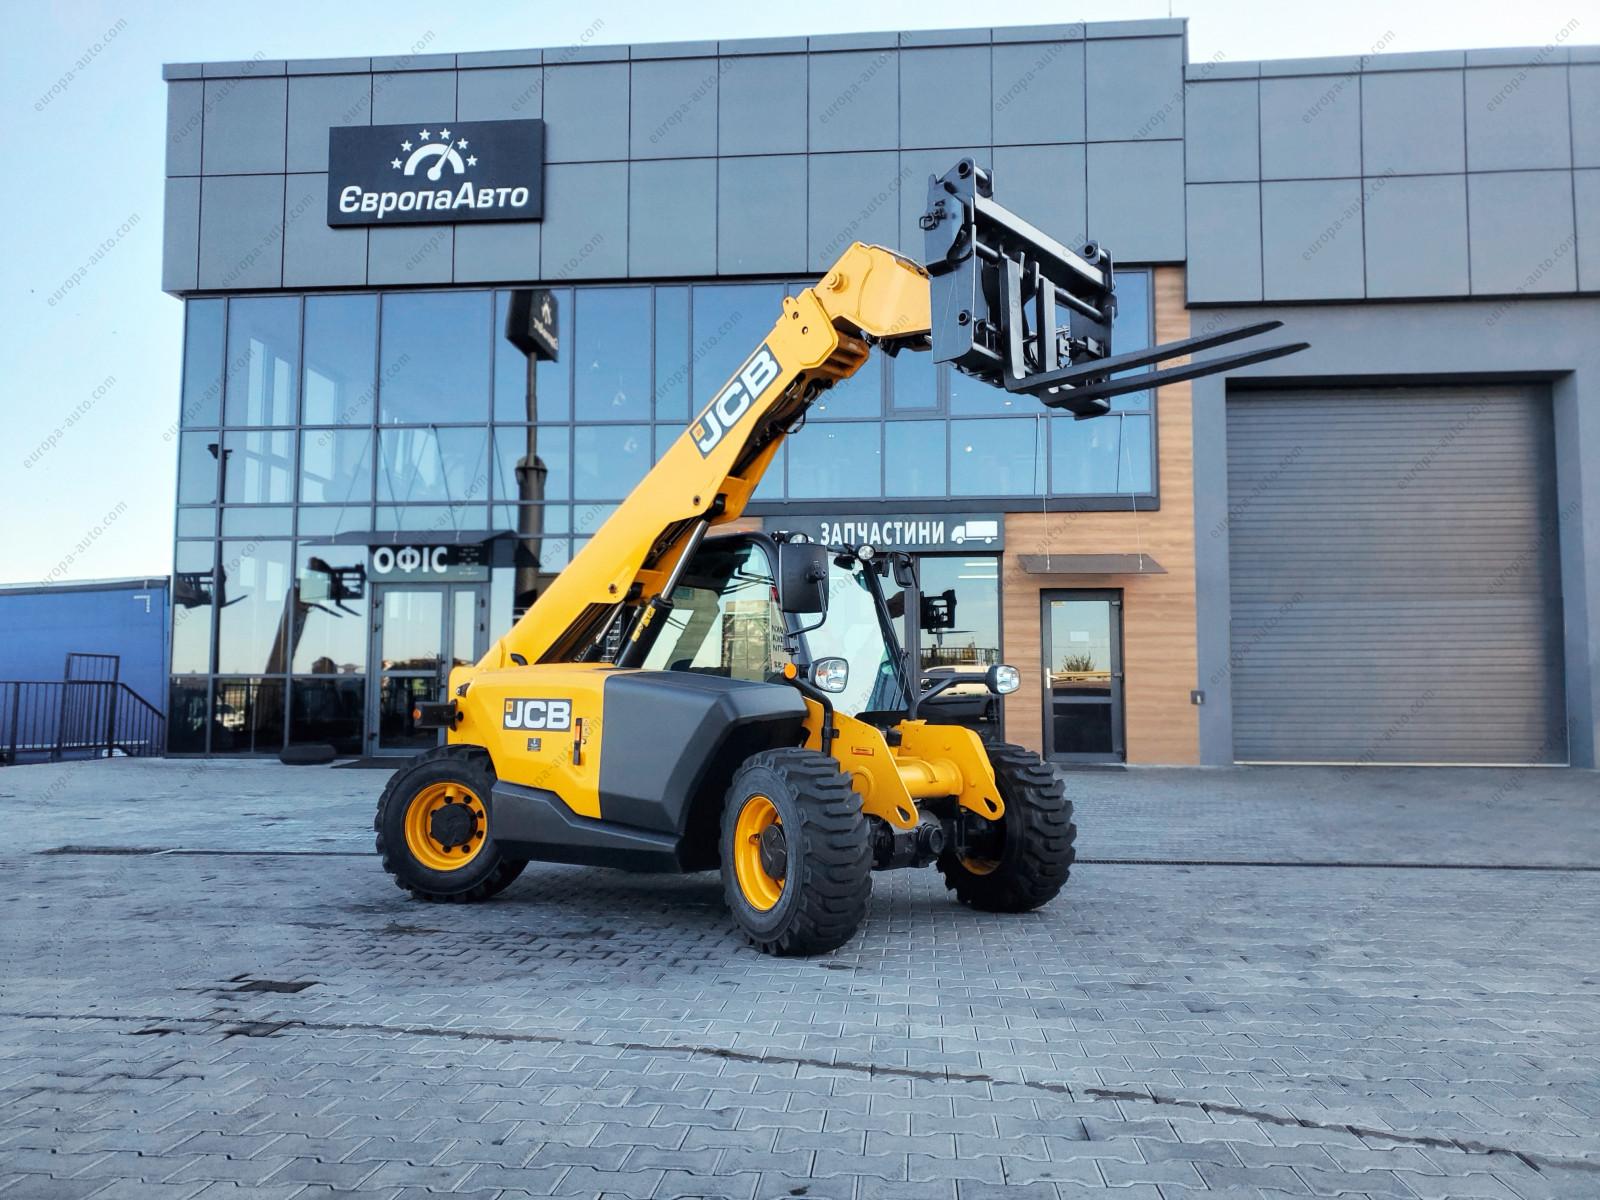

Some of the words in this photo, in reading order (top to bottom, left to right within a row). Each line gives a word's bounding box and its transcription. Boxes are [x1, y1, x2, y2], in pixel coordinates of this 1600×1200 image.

[339, 181, 529, 219] ЄвропаАвто
[698, 350, 778, 453] JCB
[820, 521, 945, 546] ЗАПЧАСТИНИ
[373, 546, 448, 574] ОФІС
[504, 700, 571, 729] JCB
